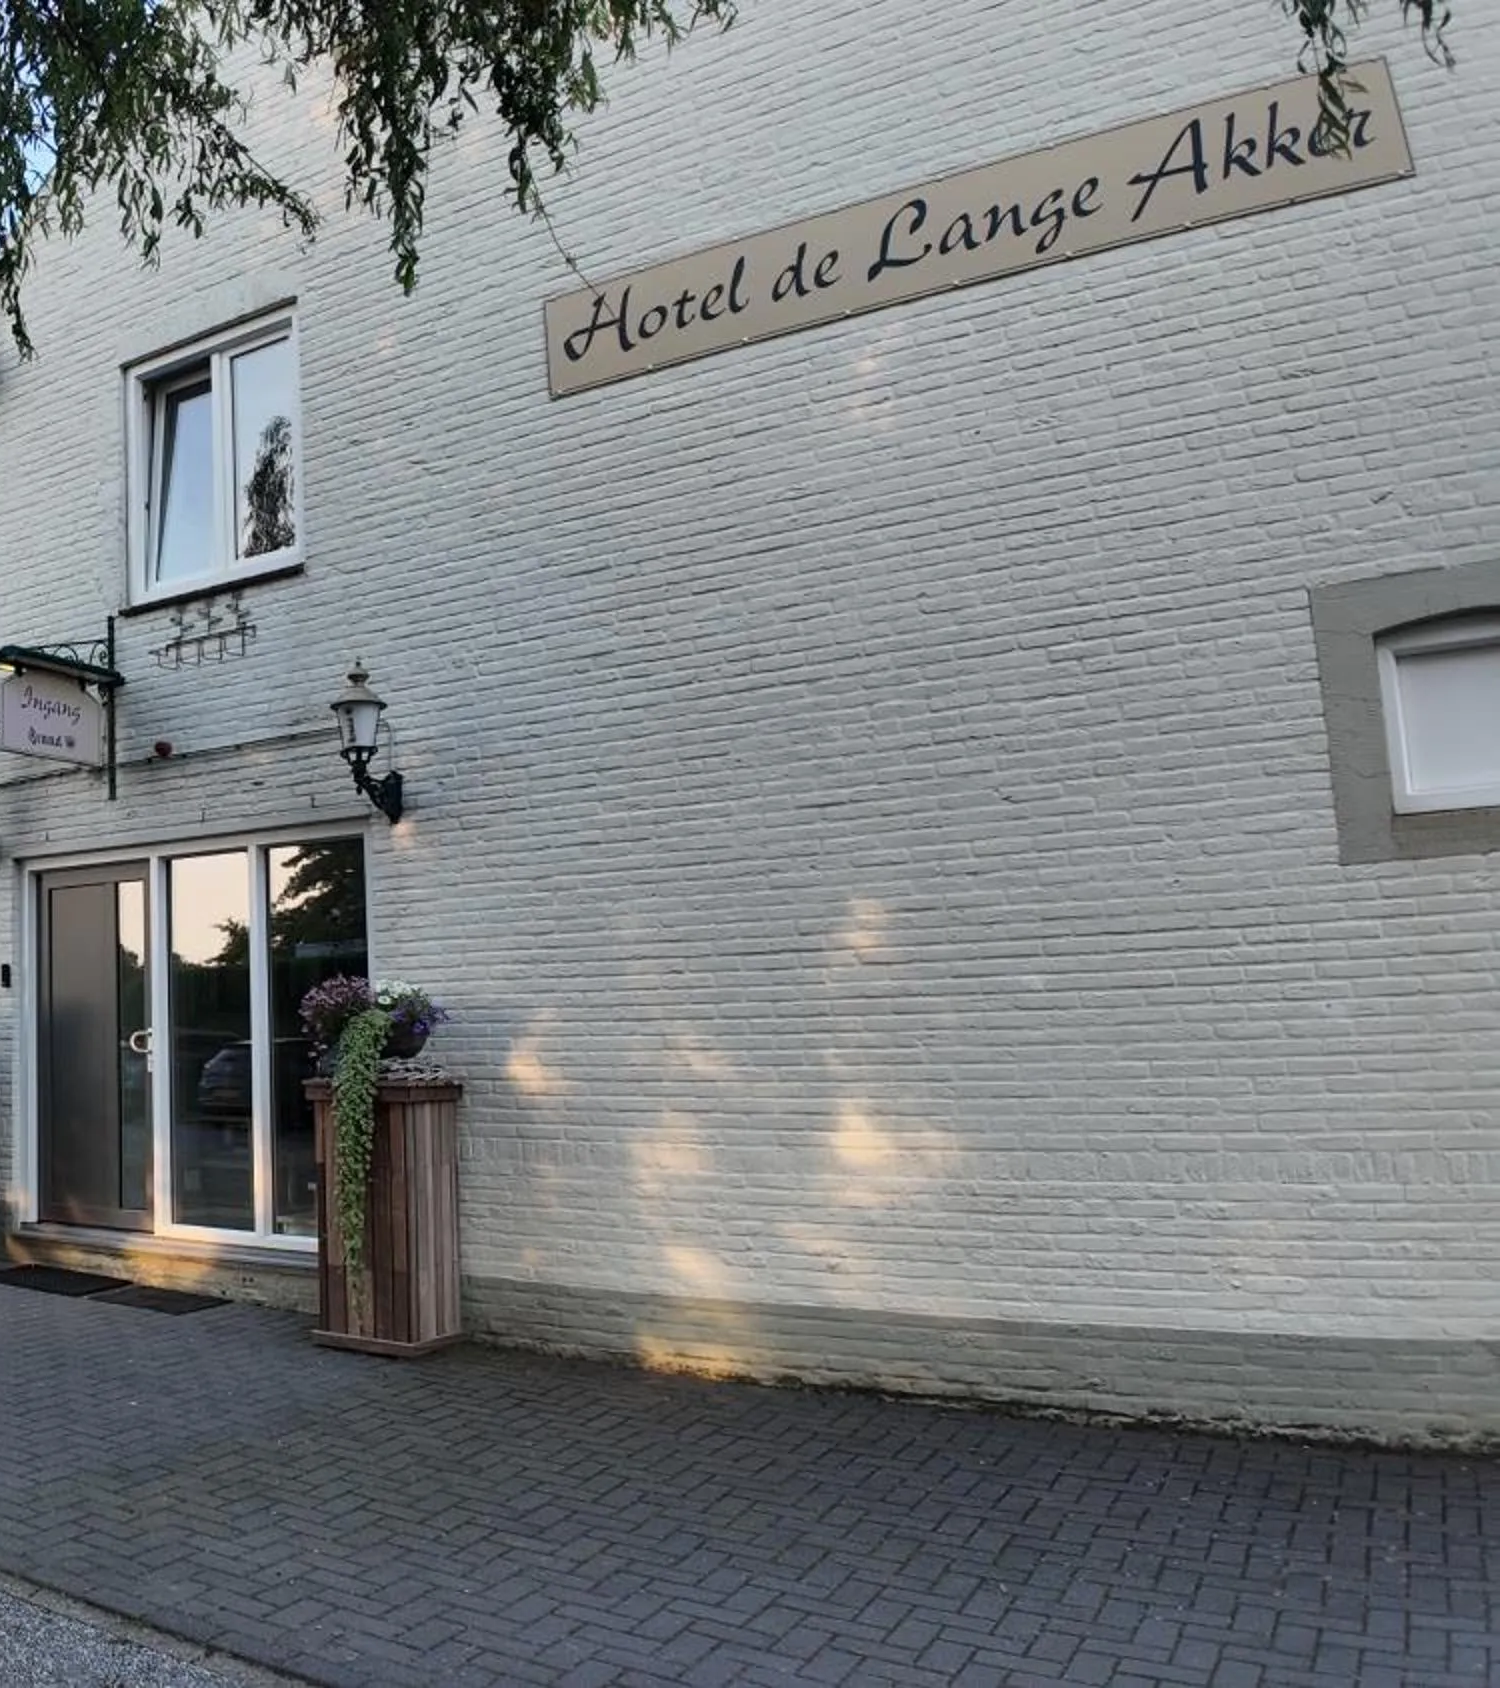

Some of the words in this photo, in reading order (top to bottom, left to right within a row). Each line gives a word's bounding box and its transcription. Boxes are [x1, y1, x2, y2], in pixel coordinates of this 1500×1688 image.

[564, 256, 750, 361] Hotel
[771, 242, 840, 303] de
[867, 175, 1102, 281] Lange
[21, 685, 81, 724] Ingang
